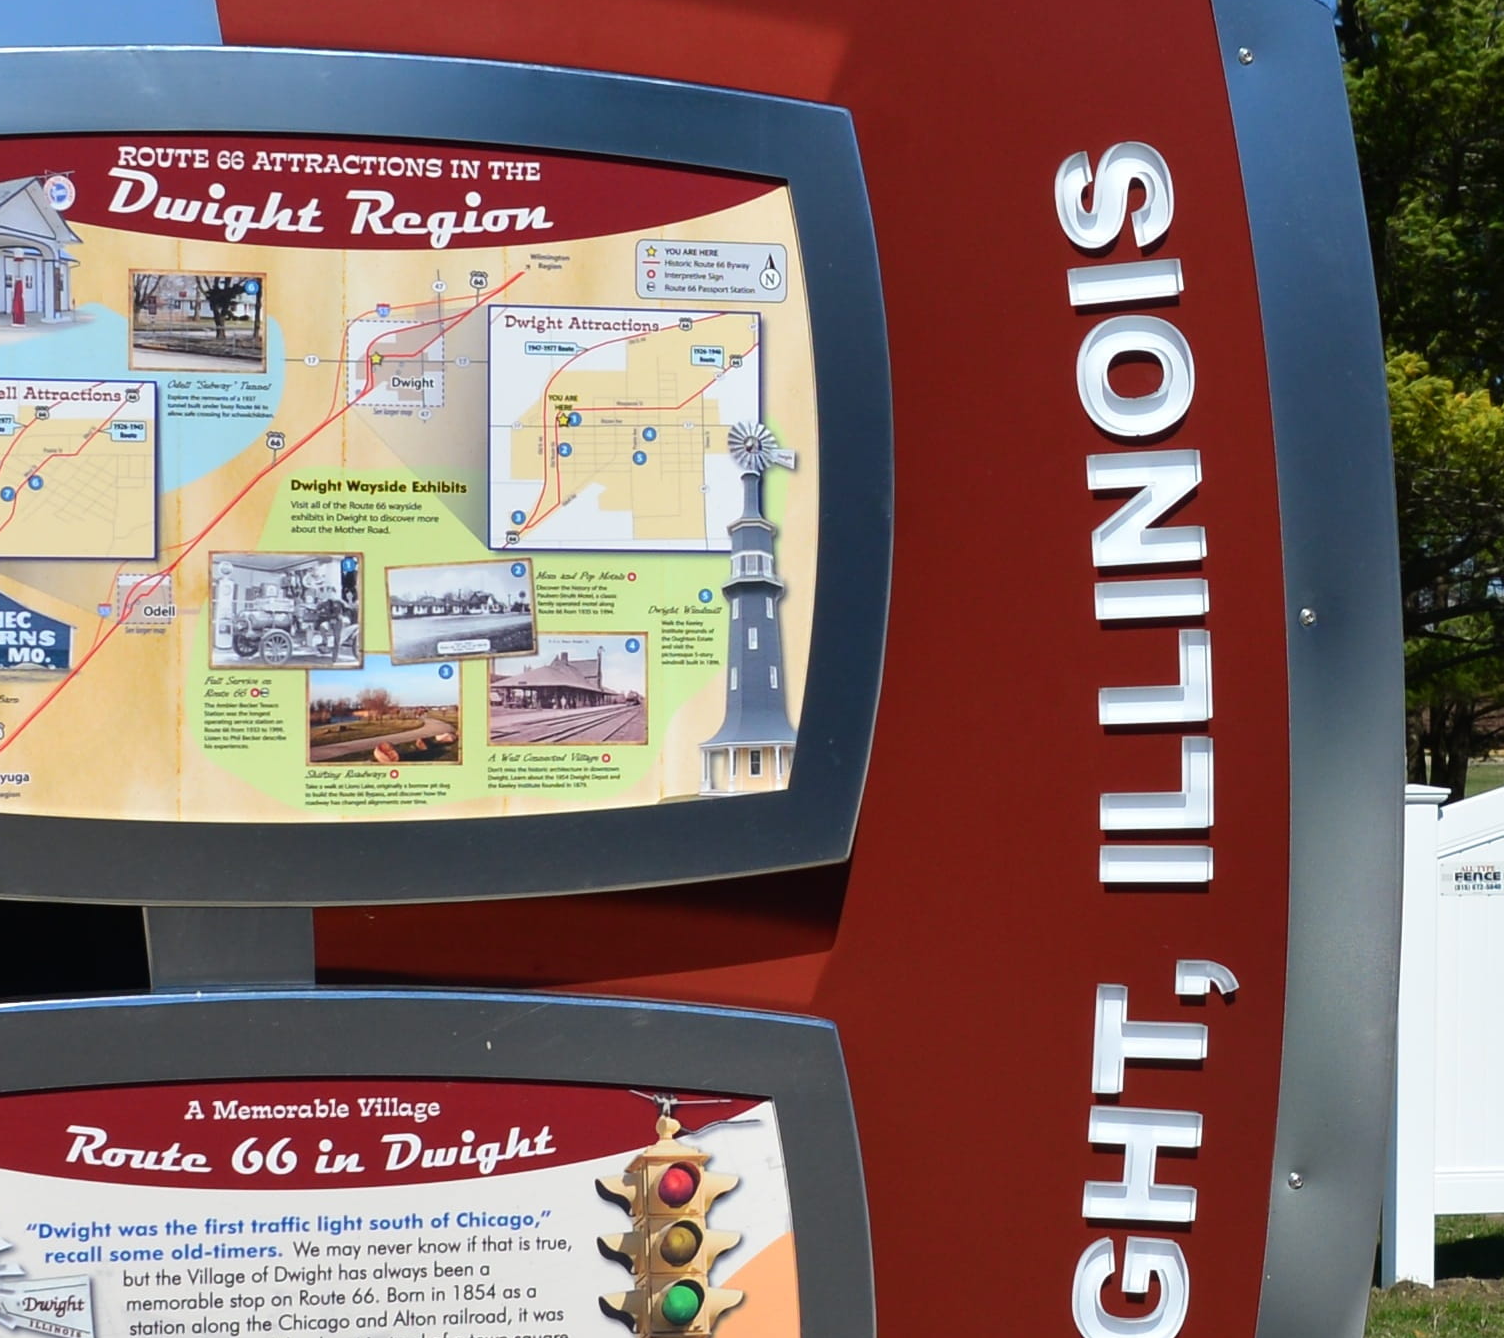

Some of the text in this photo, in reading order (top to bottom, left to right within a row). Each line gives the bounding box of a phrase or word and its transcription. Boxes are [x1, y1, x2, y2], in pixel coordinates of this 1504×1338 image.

[118, 146, 541, 181] ROUTE 66 ATTRACTIONS IN THE
[108, 167, 325, 242] Dwight
[346, 190, 554, 249] Region
[530, 253, 570, 262] Wilmington
[664, 247, 718, 257] YOU ARE HERE
[537, 262, 562, 271] Region
[664, 259, 692, 267] Historic
[693, 260, 715, 268] Route
[726, 261, 750, 271] Byway
[664, 271, 724, 282] Interpretive Sign
[765, 273, 775, 285] N
[664, 283, 686, 292] Route
[697, 284, 729, 293] Passport
[729, 285, 755, 293] Station
[504, 314, 661, 333] Dwight Attractions
[391, 375, 434, 390] Dwight
[23, 386, 121, 402] Attractions
[555, 403, 573, 412] HERE
[290, 479, 467, 495] Dwight Wayside Exhibits
[290, 500, 422, 512] Visit all of the Route 66 wayside
[1054, 140, 1216, 886] ILLINOIS
[290, 513, 324, 521] exhibits
[326, 513, 335, 522] in
[335, 512, 368, 524] Dwight
[369, 514, 379, 522] to
[379, 513, 415, 522] discover
[290, 525, 391, 534] about the Mother Road.
[143, 605, 175, 616] Odell
[8, 647, 51, 663] MO.
[184, 1097, 440, 1123] A Memorable Village
[64, 1125, 557, 1175] Route 66 in Dwight
[26, 1210, 551, 1242] "Dwight was the first traffic light south of Chicago,"
[45, 1235, 572, 1263] recall some old-timers. We may never know if that is true,
[123, 1260, 490, 1288] but the Village of Dwight has always been a
[126, 1283, 536, 1311] memorable stop on Route 66. Born in 1854 as a
[22, 1295, 85, 1318] Dwight
[29, 1320, 82, 1338] ILLINOIS
